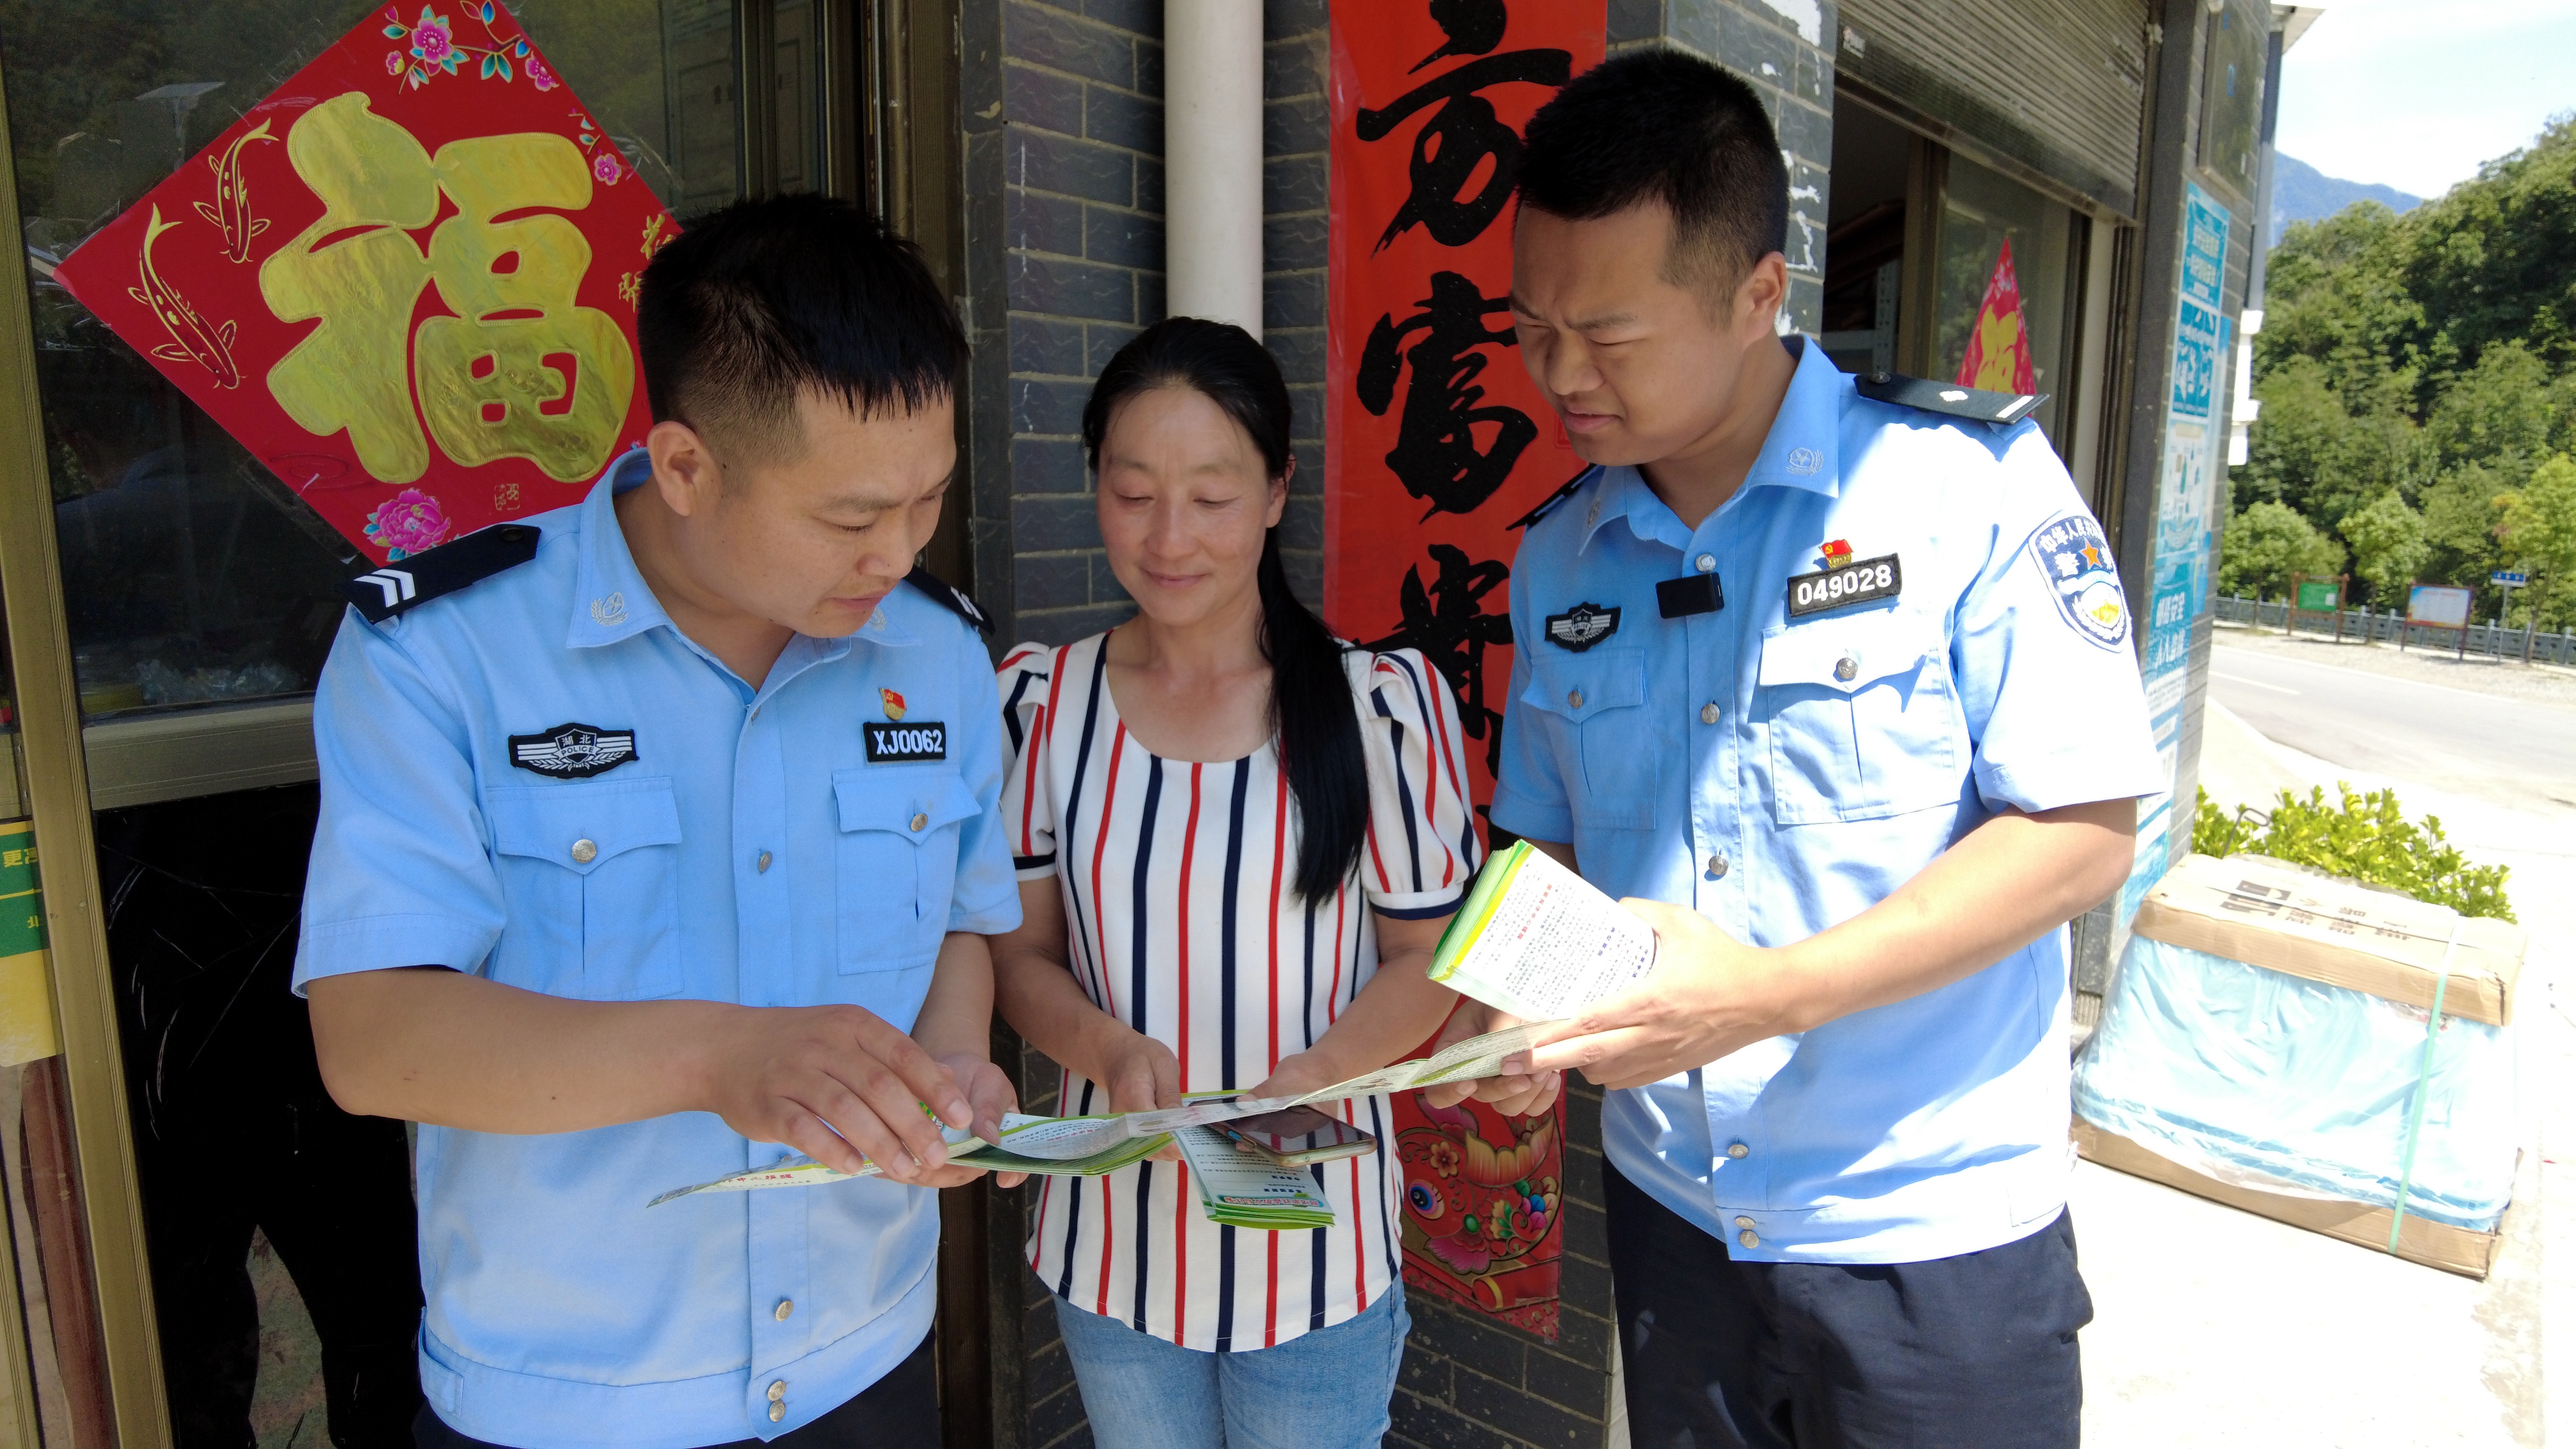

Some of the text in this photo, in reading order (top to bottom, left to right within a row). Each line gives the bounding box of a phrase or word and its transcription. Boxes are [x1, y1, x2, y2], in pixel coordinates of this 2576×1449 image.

[259, 92, 635, 483] 福
[1797, 564, 1893, 606] 049028
[561, 746, 594, 756] POLICE
[562, 735, 591, 746] 湖北
[873, 729, 943, 755] XJ0062
